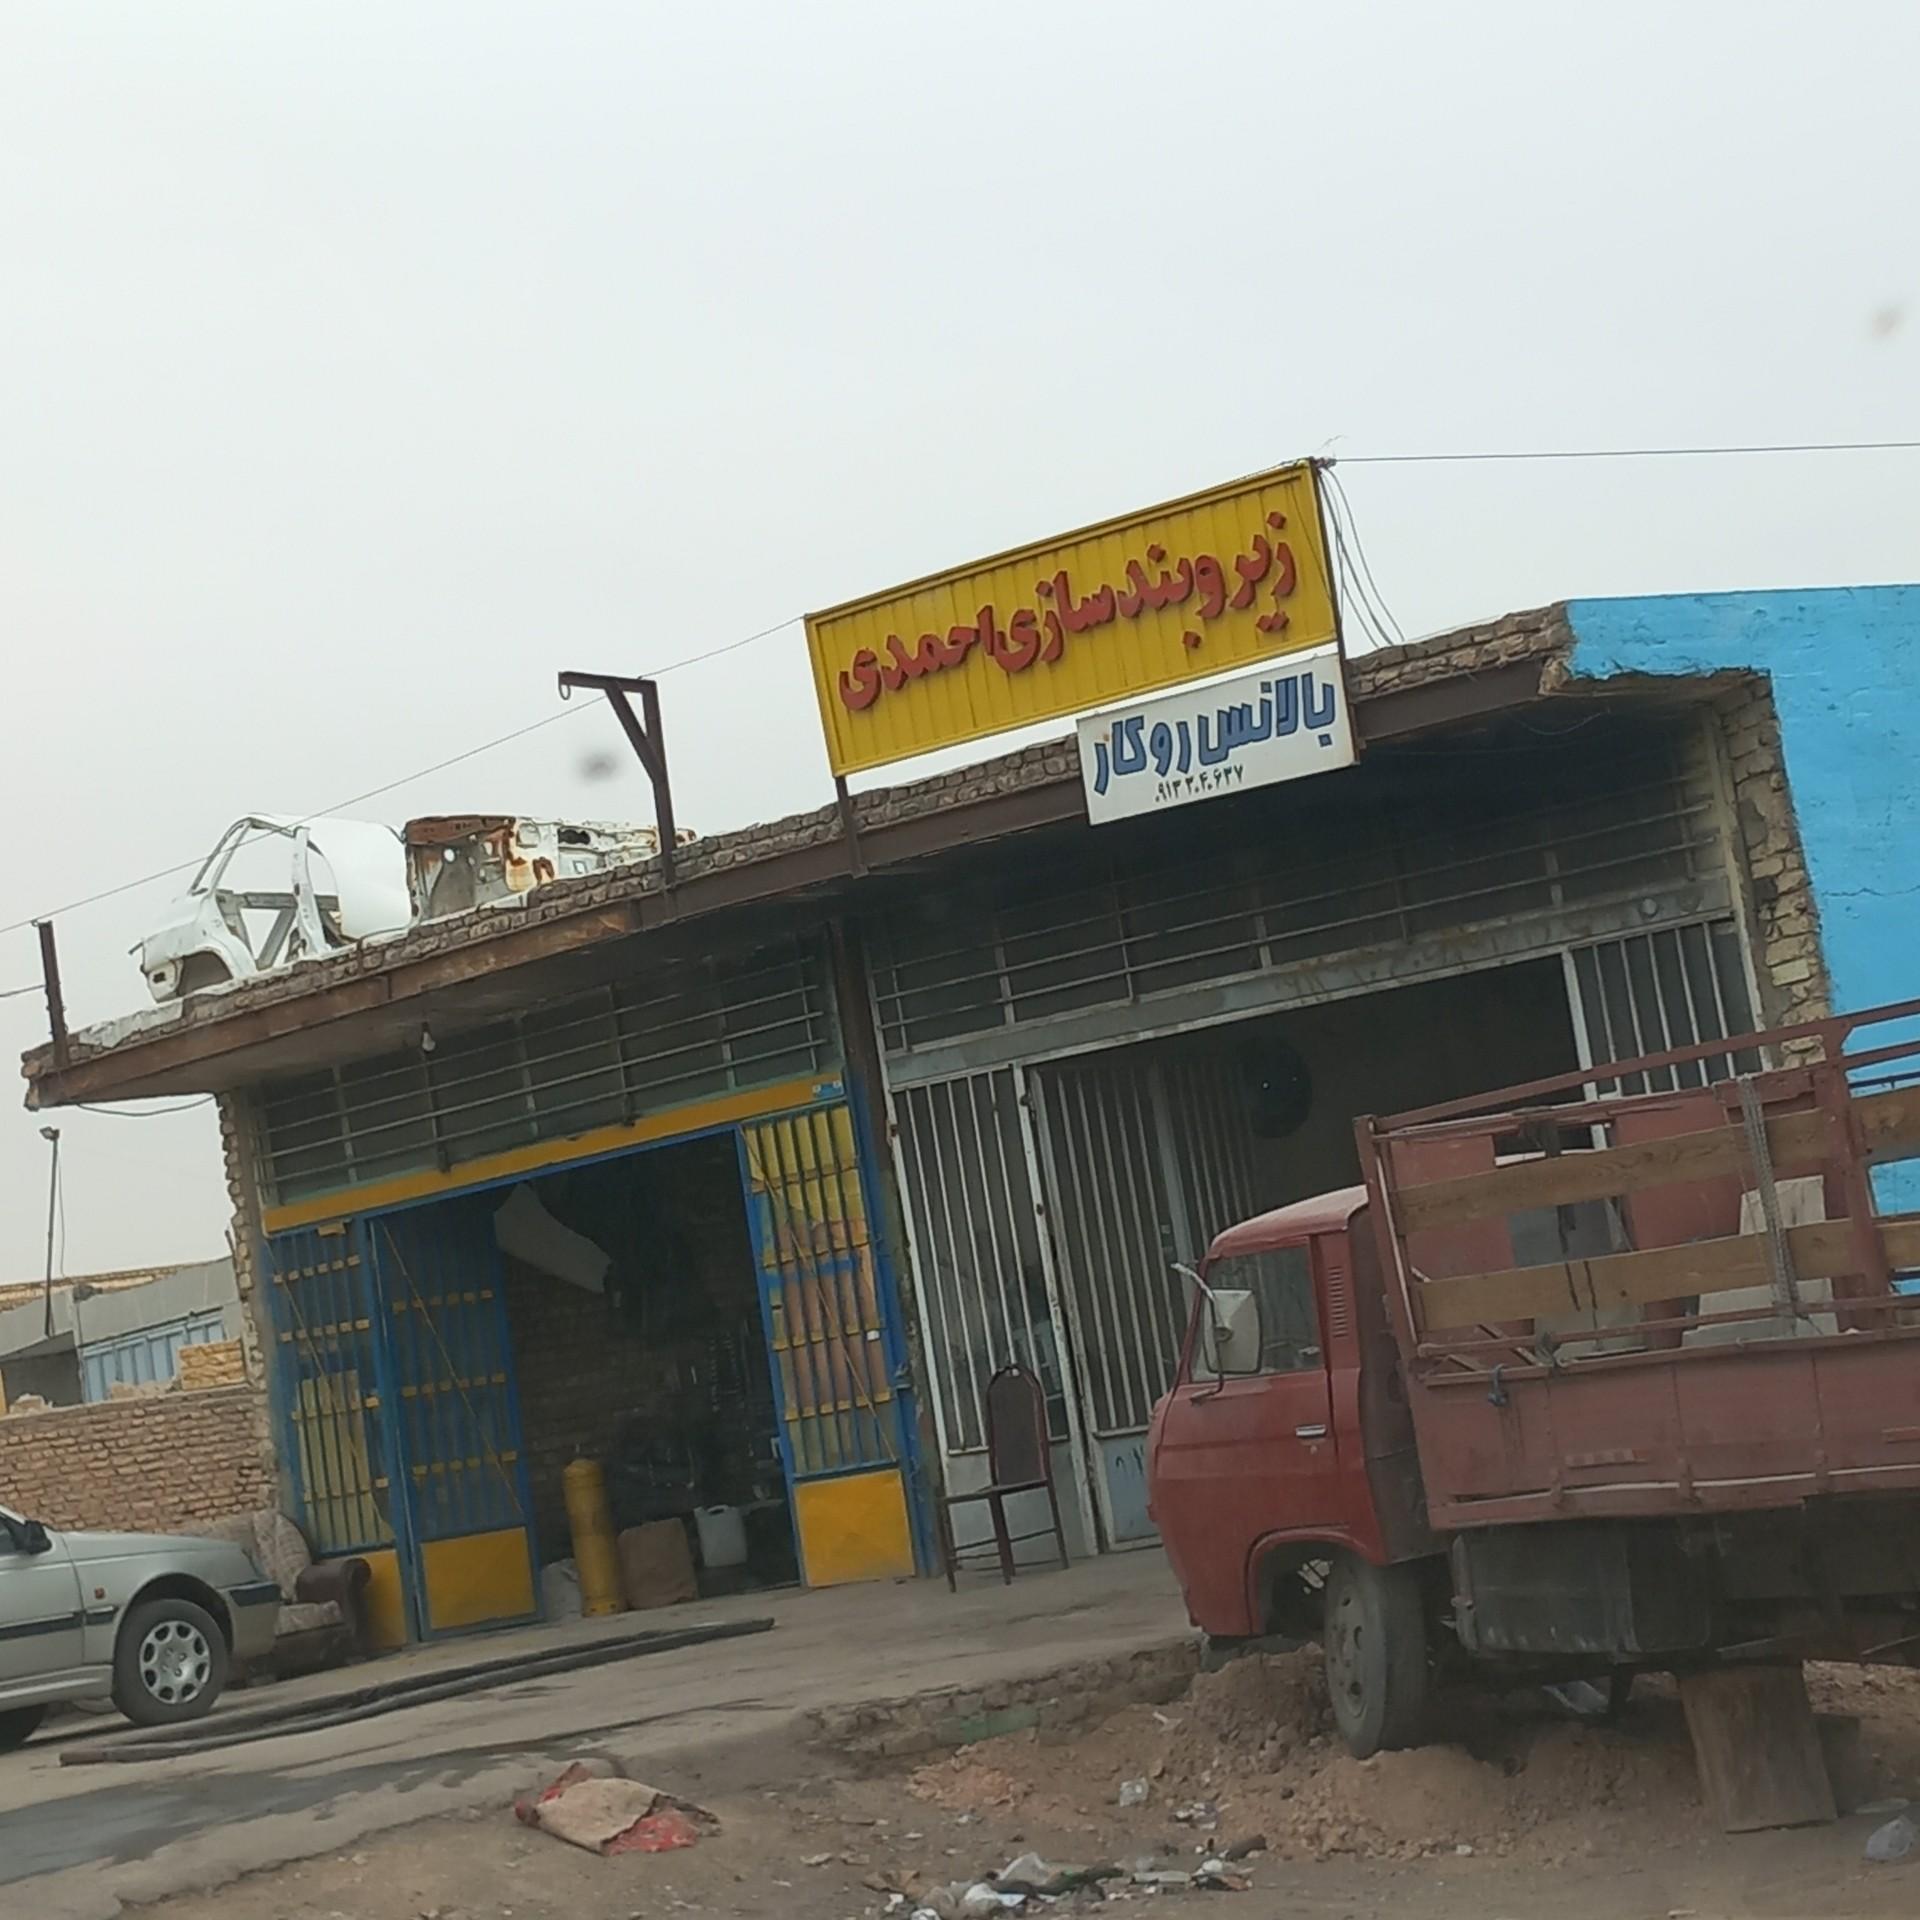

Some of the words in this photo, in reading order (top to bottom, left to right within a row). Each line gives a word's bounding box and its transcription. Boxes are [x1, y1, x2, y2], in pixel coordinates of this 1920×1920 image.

[838, 604, 994, 711] احمدی
[994, 569, 1116, 673] سازی
[1197, 671, 1336, 766] بالانس
